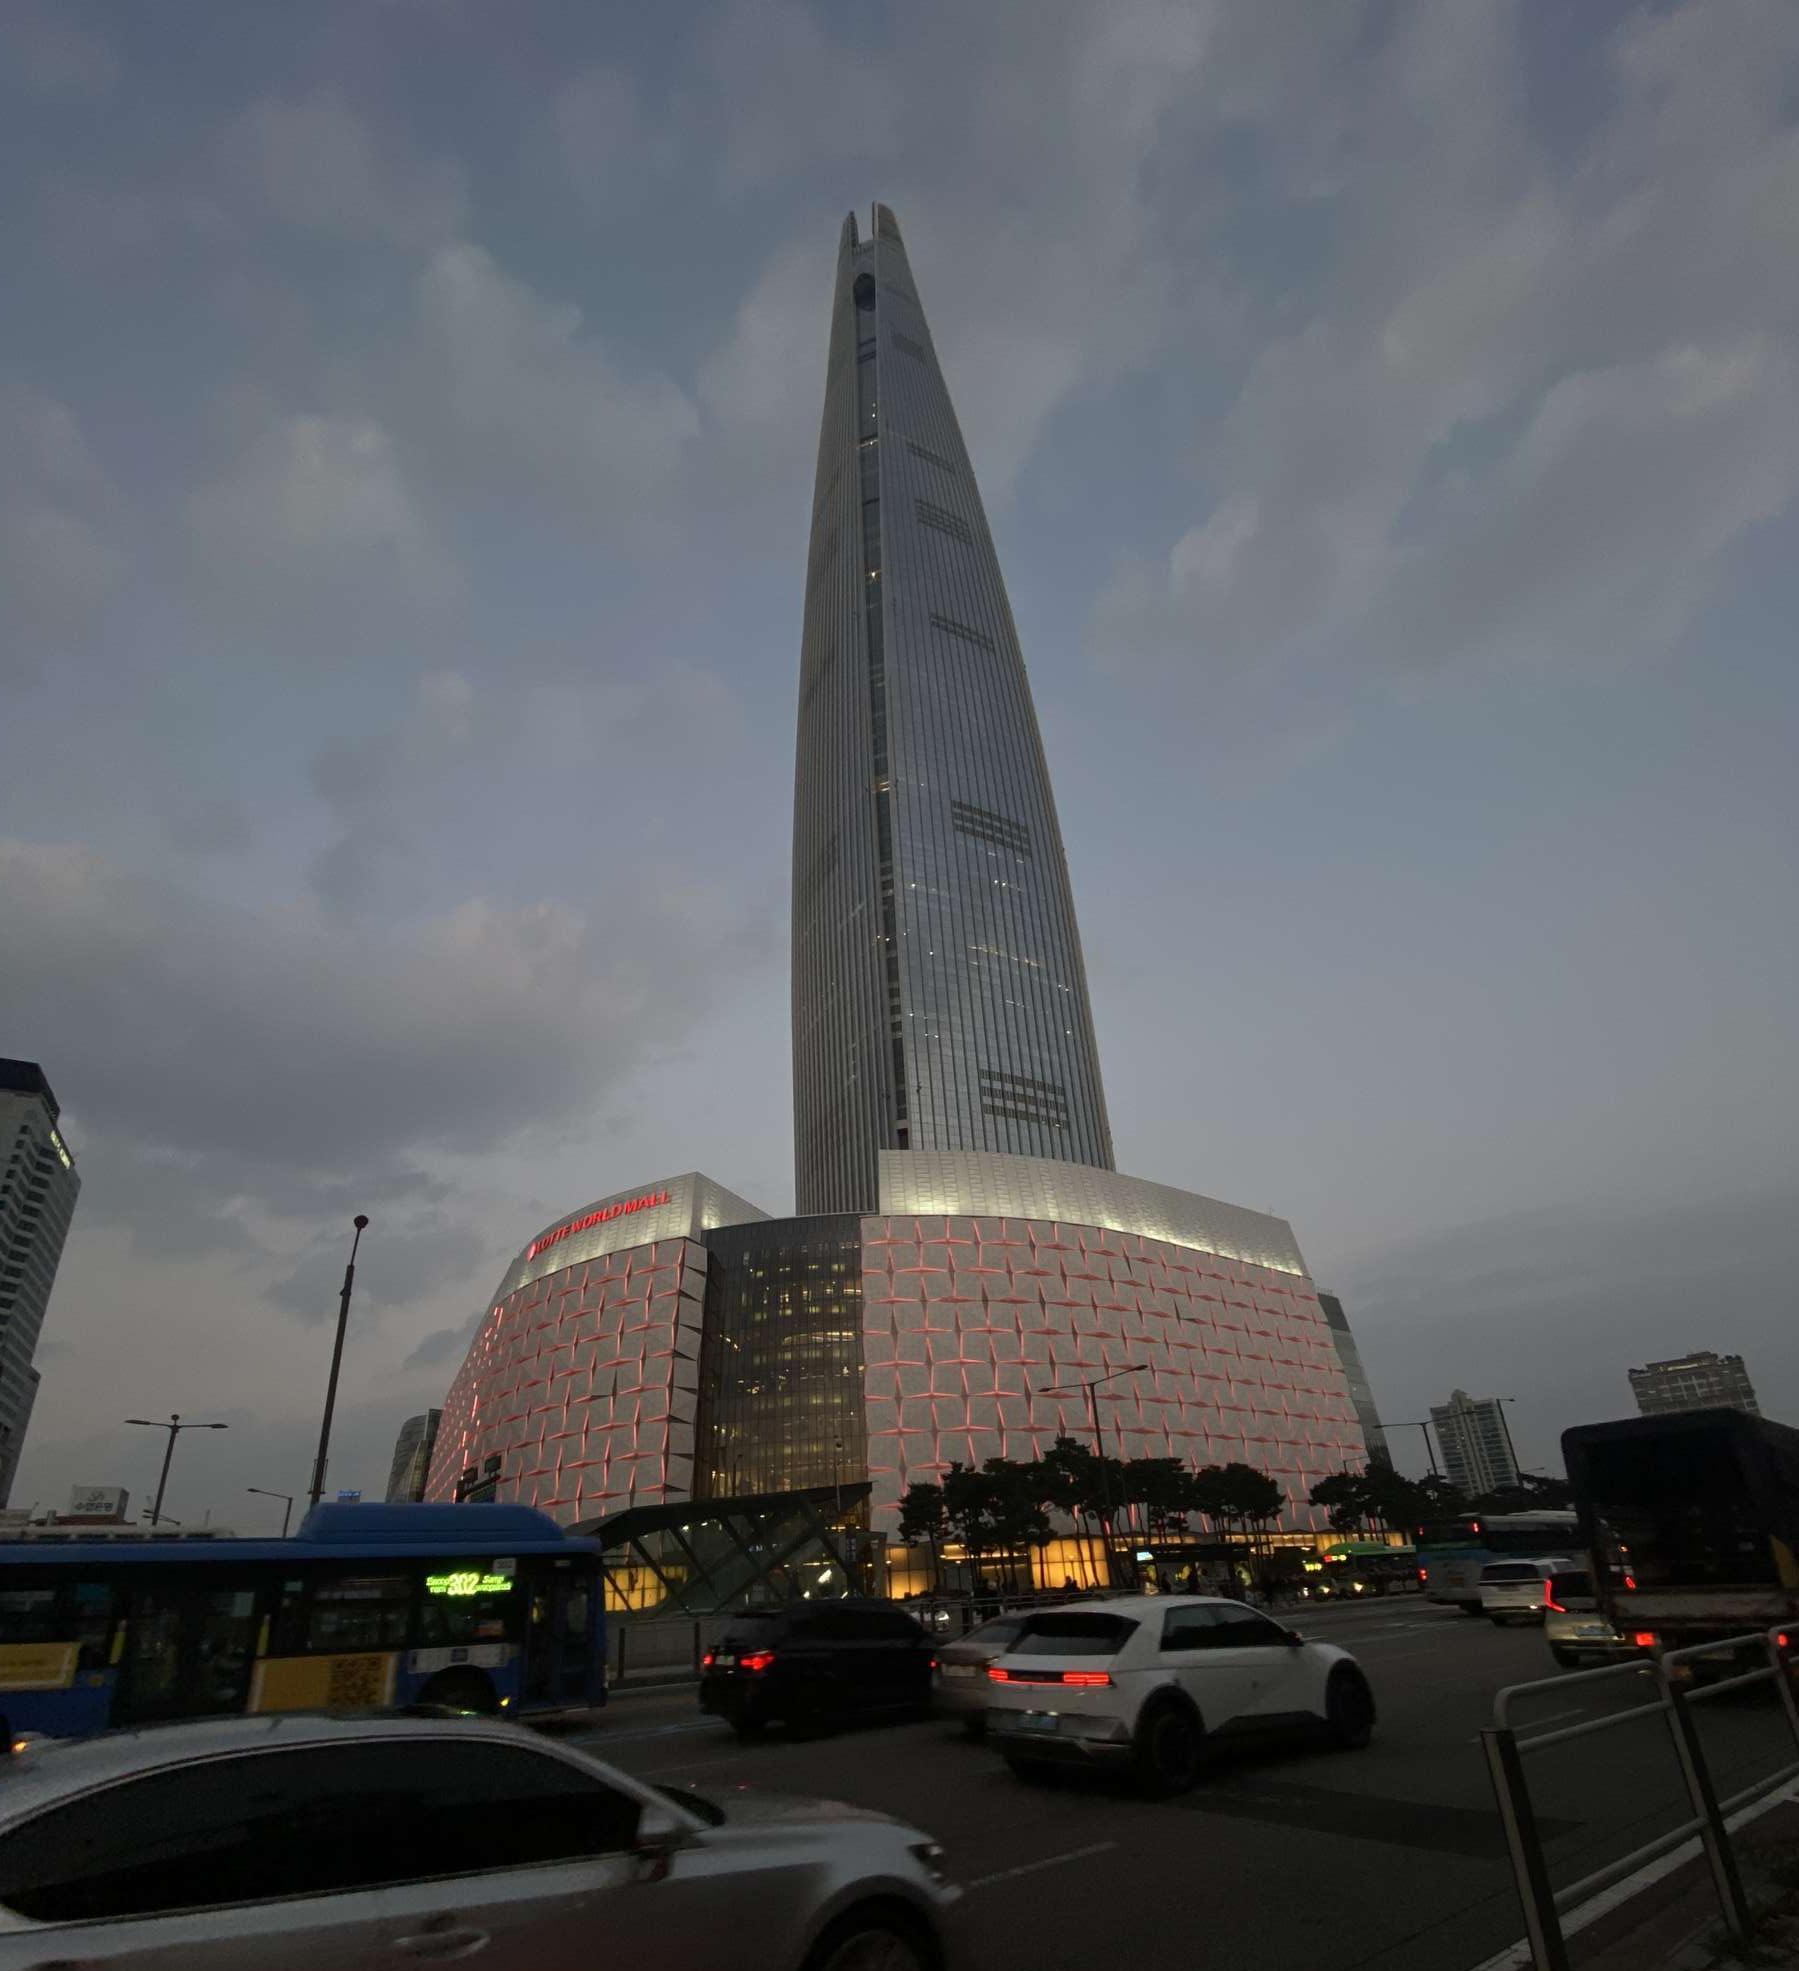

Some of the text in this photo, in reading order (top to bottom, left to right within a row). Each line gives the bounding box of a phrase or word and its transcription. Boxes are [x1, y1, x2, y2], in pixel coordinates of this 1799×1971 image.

[571, 1204, 622, 1232] WORLD
[624, 1190, 670, 1214] MALL
[447, 1573, 480, 1596] 302
